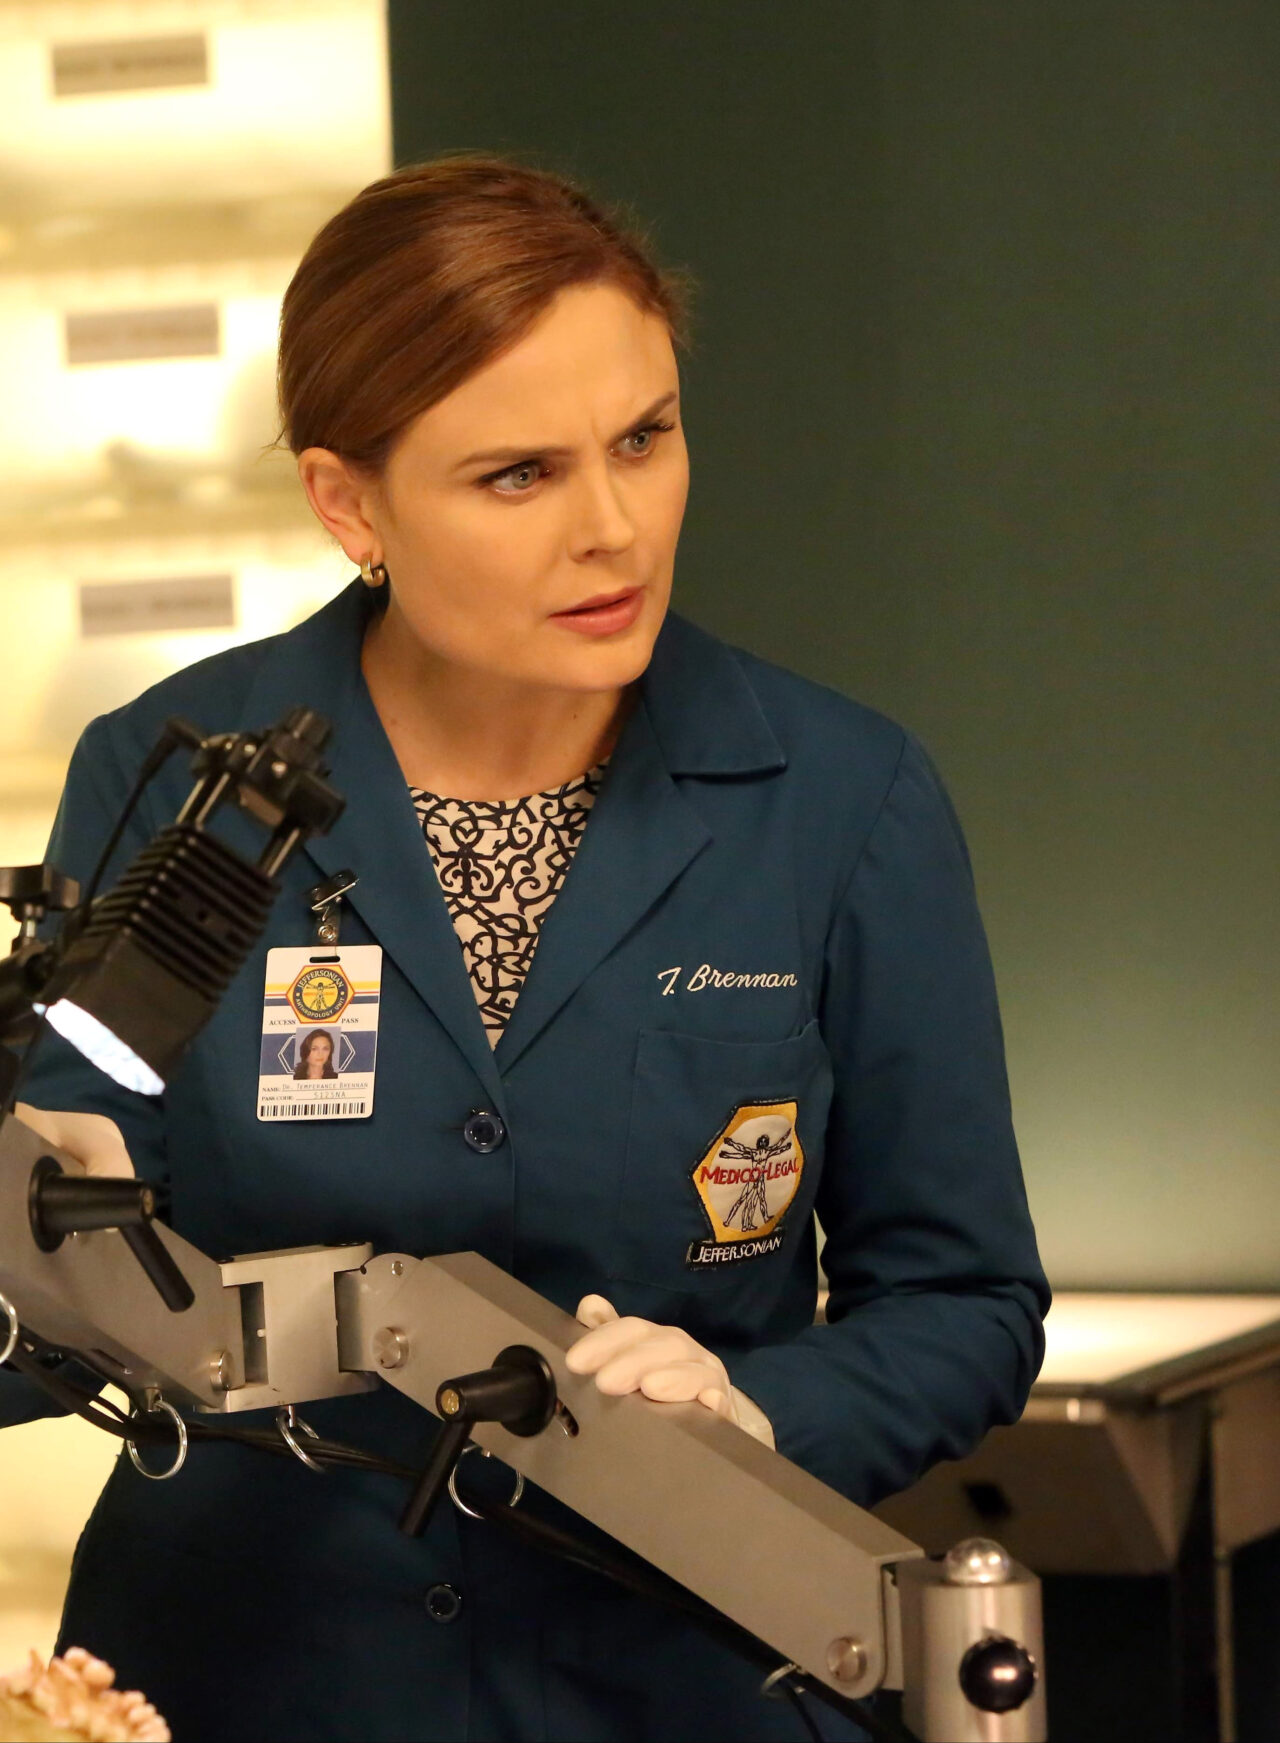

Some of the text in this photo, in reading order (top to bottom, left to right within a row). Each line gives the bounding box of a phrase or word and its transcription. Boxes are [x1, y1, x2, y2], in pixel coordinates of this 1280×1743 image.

[297, 969, 345, 988] JEFFERSONIAN
[657, 964, 797, 996] T. Brennan
[296, 998, 334, 1018] ANTHROPOLOGY
[699, 1158, 800, 1185] MEDICO-LEGAL
[692, 1237, 782, 1263] JEFFERSONIAN
